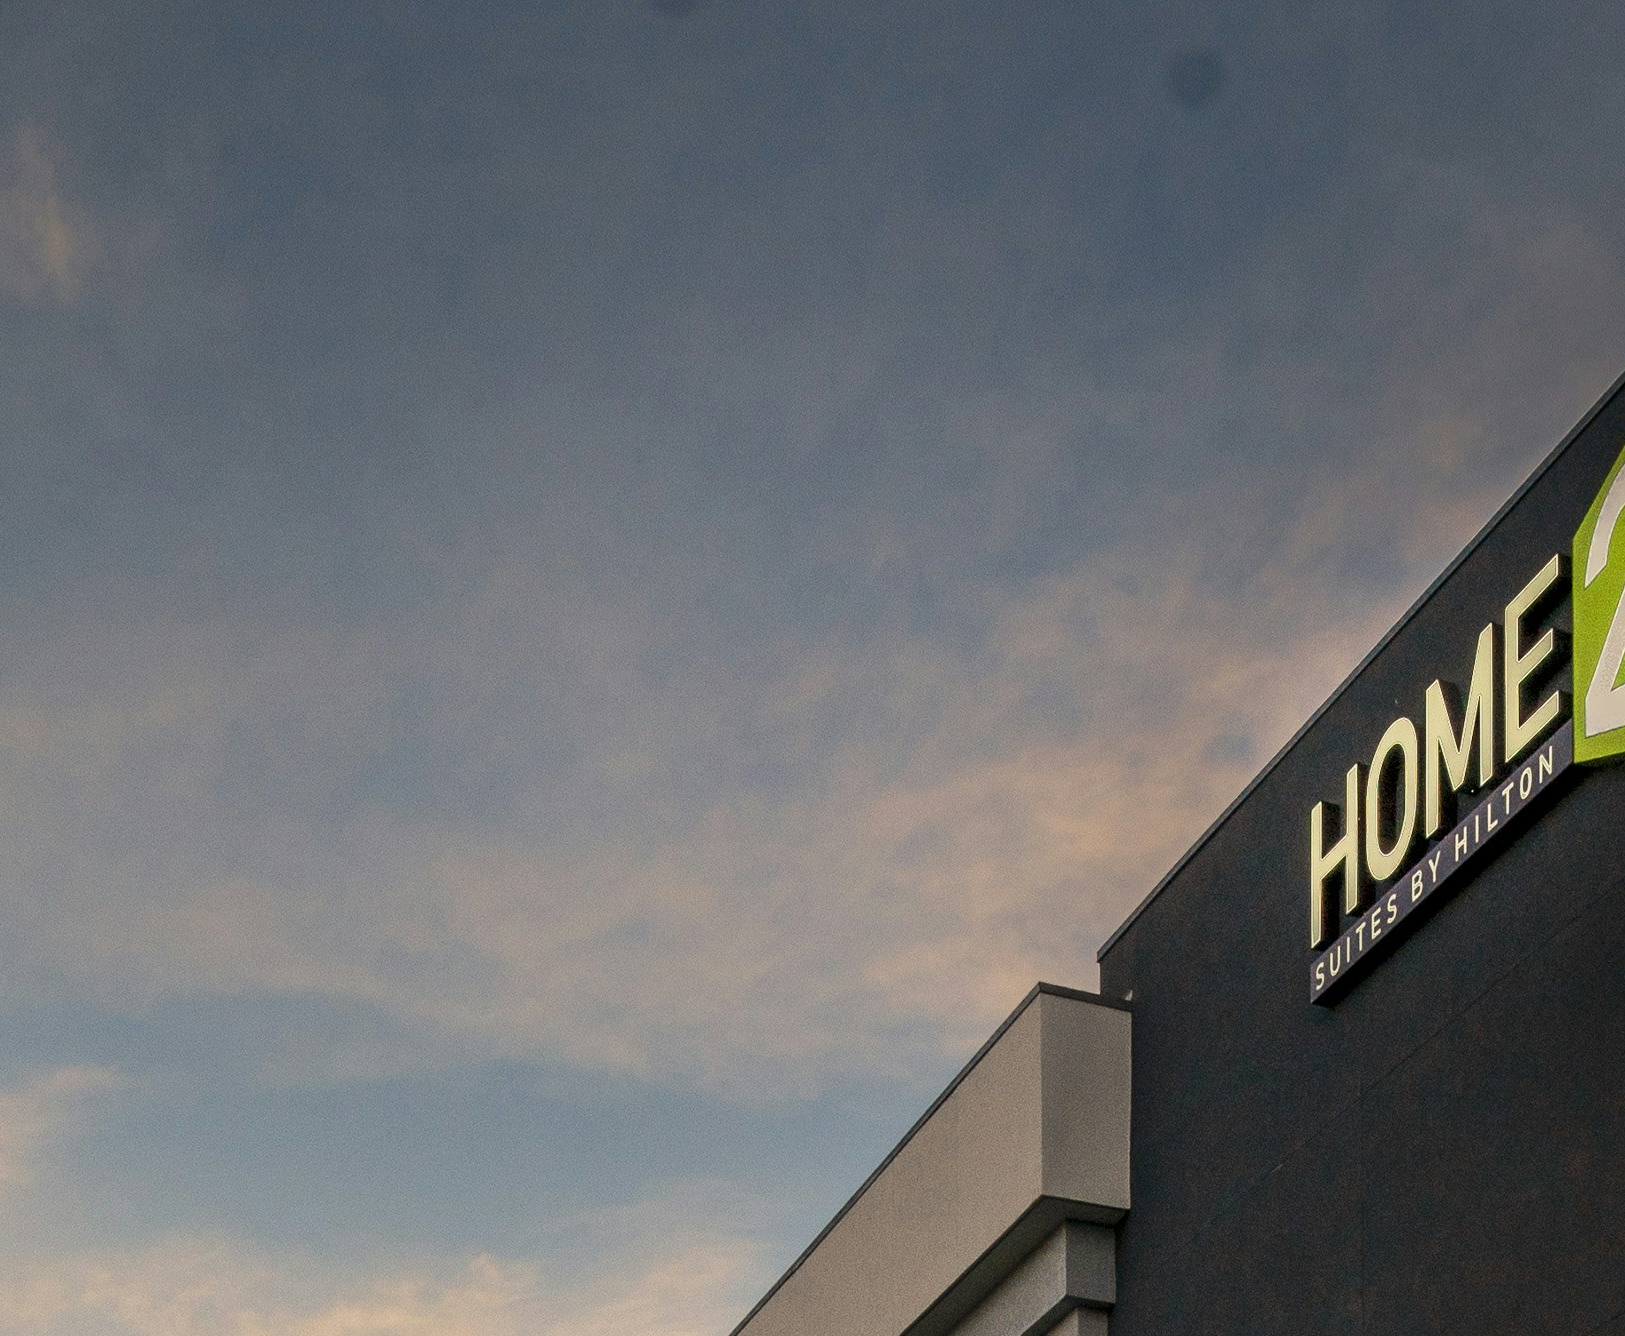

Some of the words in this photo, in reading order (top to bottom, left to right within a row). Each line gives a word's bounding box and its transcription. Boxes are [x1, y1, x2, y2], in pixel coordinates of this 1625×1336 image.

[1311, 554, 1560, 949] HOME
[1315, 893, 1398, 991] SUITES
[1411, 851, 1442, 903] BY
[1454, 746, 1554, 862] HILTON
